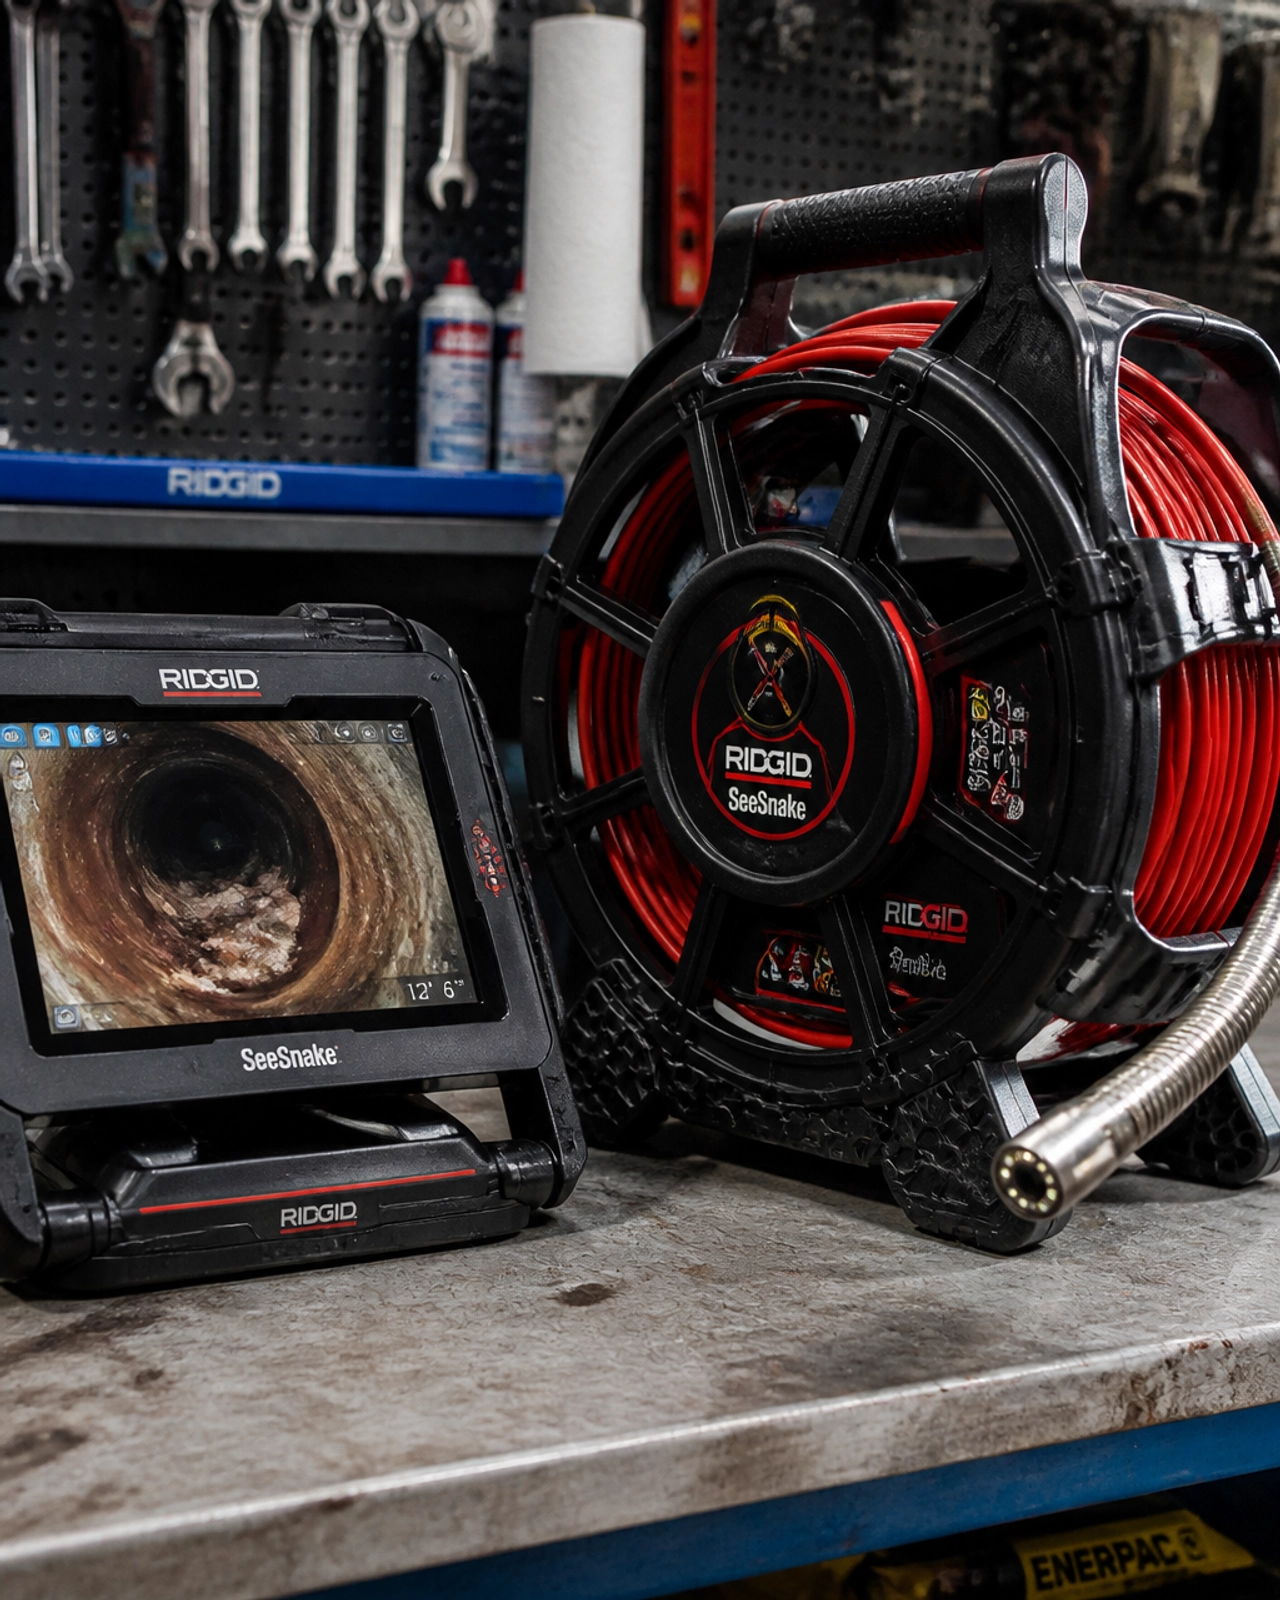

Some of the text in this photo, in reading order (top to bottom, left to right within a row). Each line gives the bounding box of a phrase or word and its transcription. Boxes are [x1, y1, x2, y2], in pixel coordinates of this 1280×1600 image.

[167, 467, 282, 499] RIDGID
[159, 668, 259, 689] RIDGID
[725, 745, 812, 778] RIDGID
[728, 786, 806, 820] SeeSnake
[884, 900, 968, 933] RIDGID
[241, 1043, 338, 1071] SeeSnake
[281, 1201, 357, 1227] RIDGID
[1030, 1533, 1179, 1592] ENERPAC
